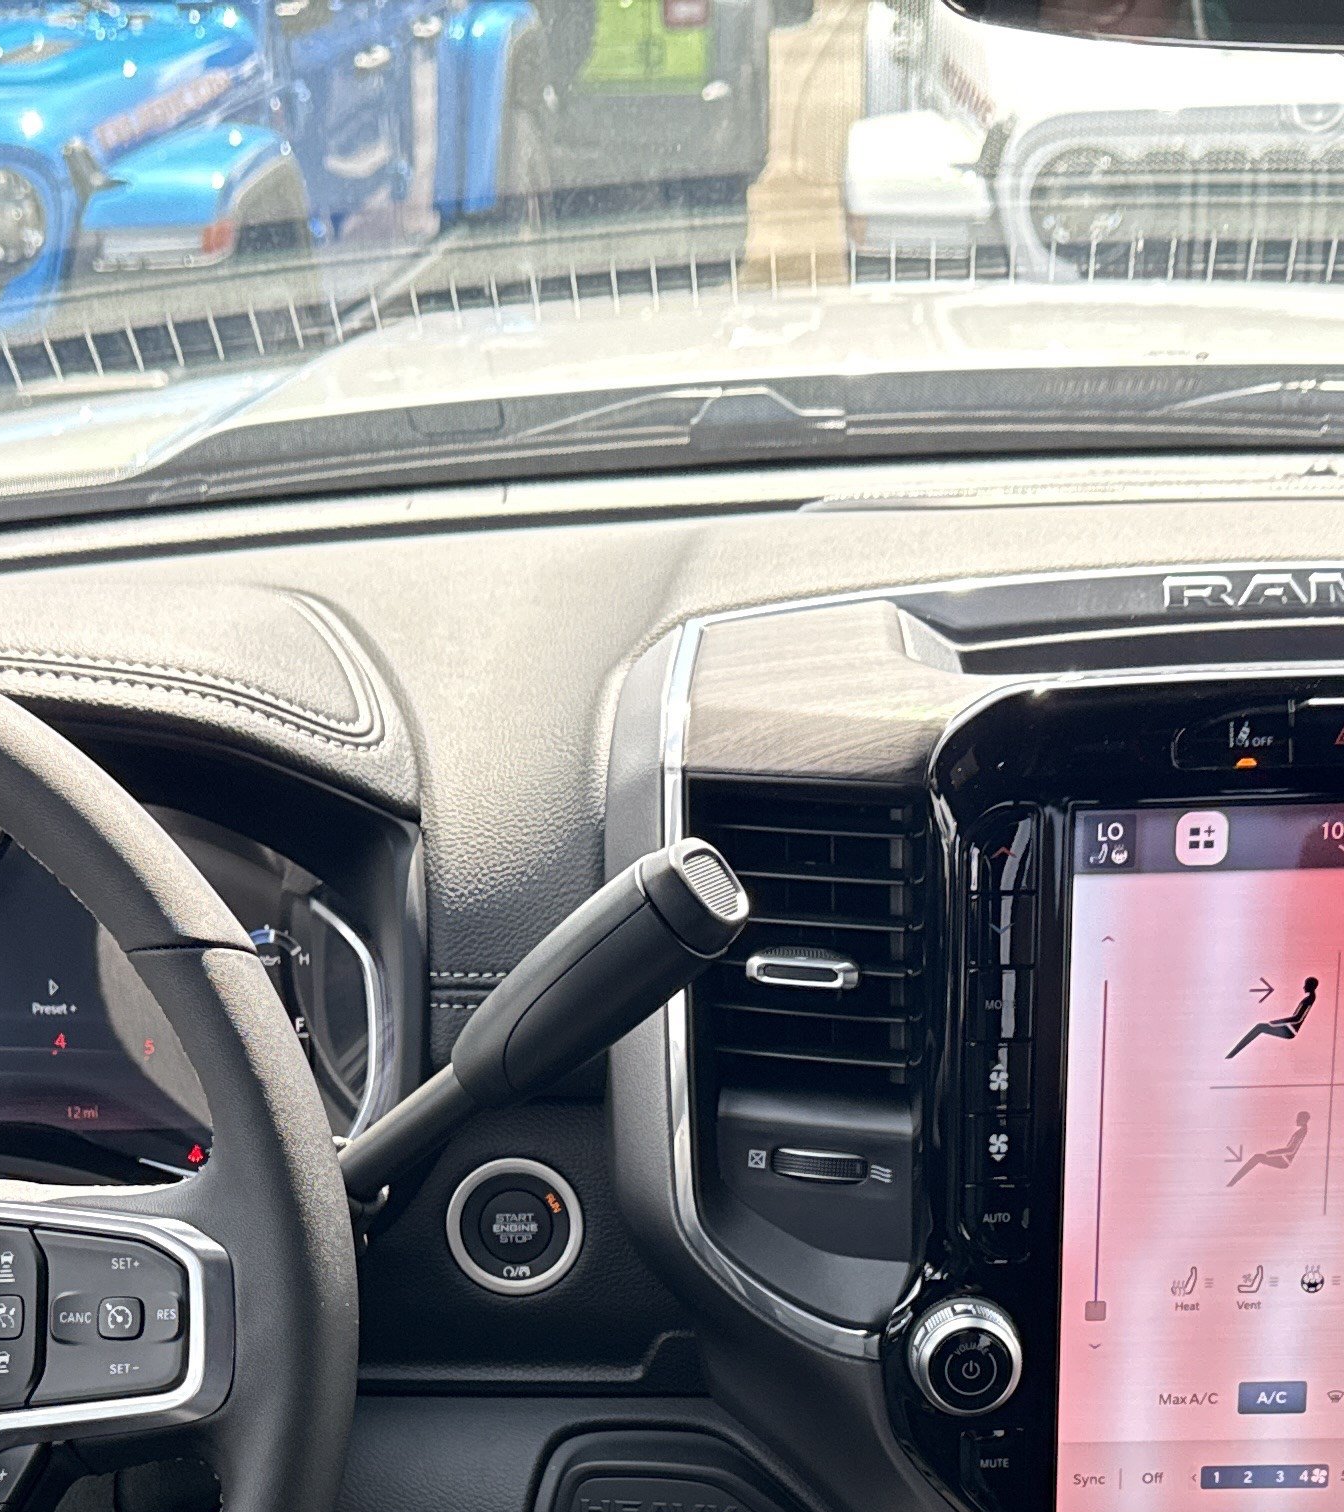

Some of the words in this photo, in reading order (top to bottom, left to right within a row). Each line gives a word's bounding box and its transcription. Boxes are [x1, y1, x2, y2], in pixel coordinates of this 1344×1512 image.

[1252, 736, 1274, 748] OFF
[1097, 822, 1124, 841] LO
[299, 952, 310, 966] H
[32, 1003, 68, 1016] Preset
[294, 1016, 305, 1032] F
[54, 1032, 68, 1049] 4
[142, 1038, 155, 1056] 5
[66, 1104, 82, 1120] 12
[83, 1105, 99, 1119] mi
[495, 1212, 534, 1223] START
[982, 1212, 1012, 1224] AUTO
[492, 1222, 538, 1233] ENGINE
[499, 1233, 533, 1244] STOP
[1174, 1301, 1200, 1312] Heat
[1236, 1300, 1262, 1311] Vent
[59, 1311, 92, 1325] CANC
[156, 1308, 177, 1321] RES
[1158, 1393, 1188, 1406] Max
[1188, 1392, 1220, 1406] A/C
[1256, 1391, 1288, 1405] A/C
[979, 1459, 1010, 1469] MUTE
[1073, 1473, 1106, 1488] Sync
[1142, 1472, 1164, 1485] Off
[1212, 1470, 1221, 1483] 1
[1243, 1470, 1253, 1483] 2
[1275, 1470, 1285, 1483] 3
[1299, 1470, 1310, 1483] 4
